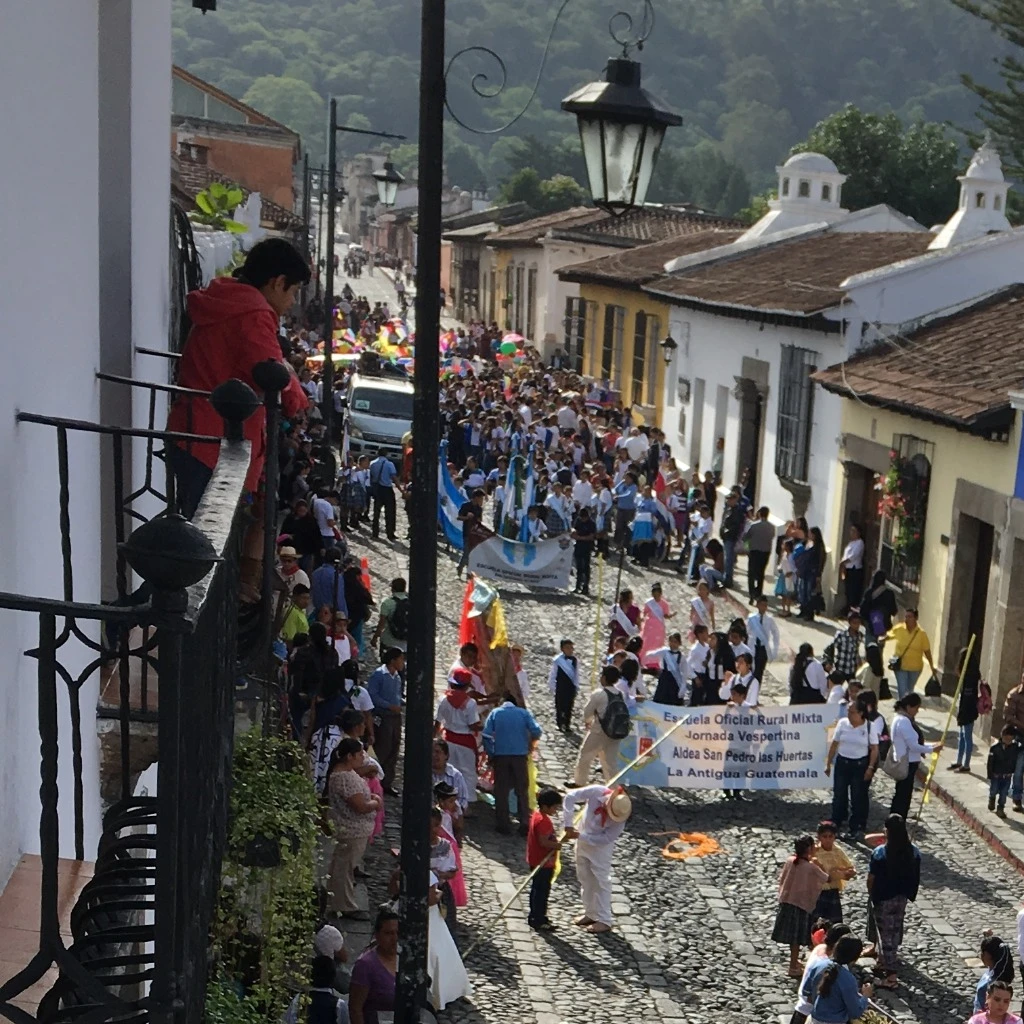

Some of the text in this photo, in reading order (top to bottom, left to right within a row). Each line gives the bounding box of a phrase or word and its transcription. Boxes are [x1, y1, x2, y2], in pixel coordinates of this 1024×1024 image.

[714, 713, 754, 726] Oficial
[757, 713, 788, 725] Rural
[792, 712, 823, 724] Mixta
[686, 730, 800, 745] Jornada Vespertina
[673, 746, 813, 764] Aldea San Pedro las Huertas
[667, 766, 819, 781] La Antigua Guatemala
